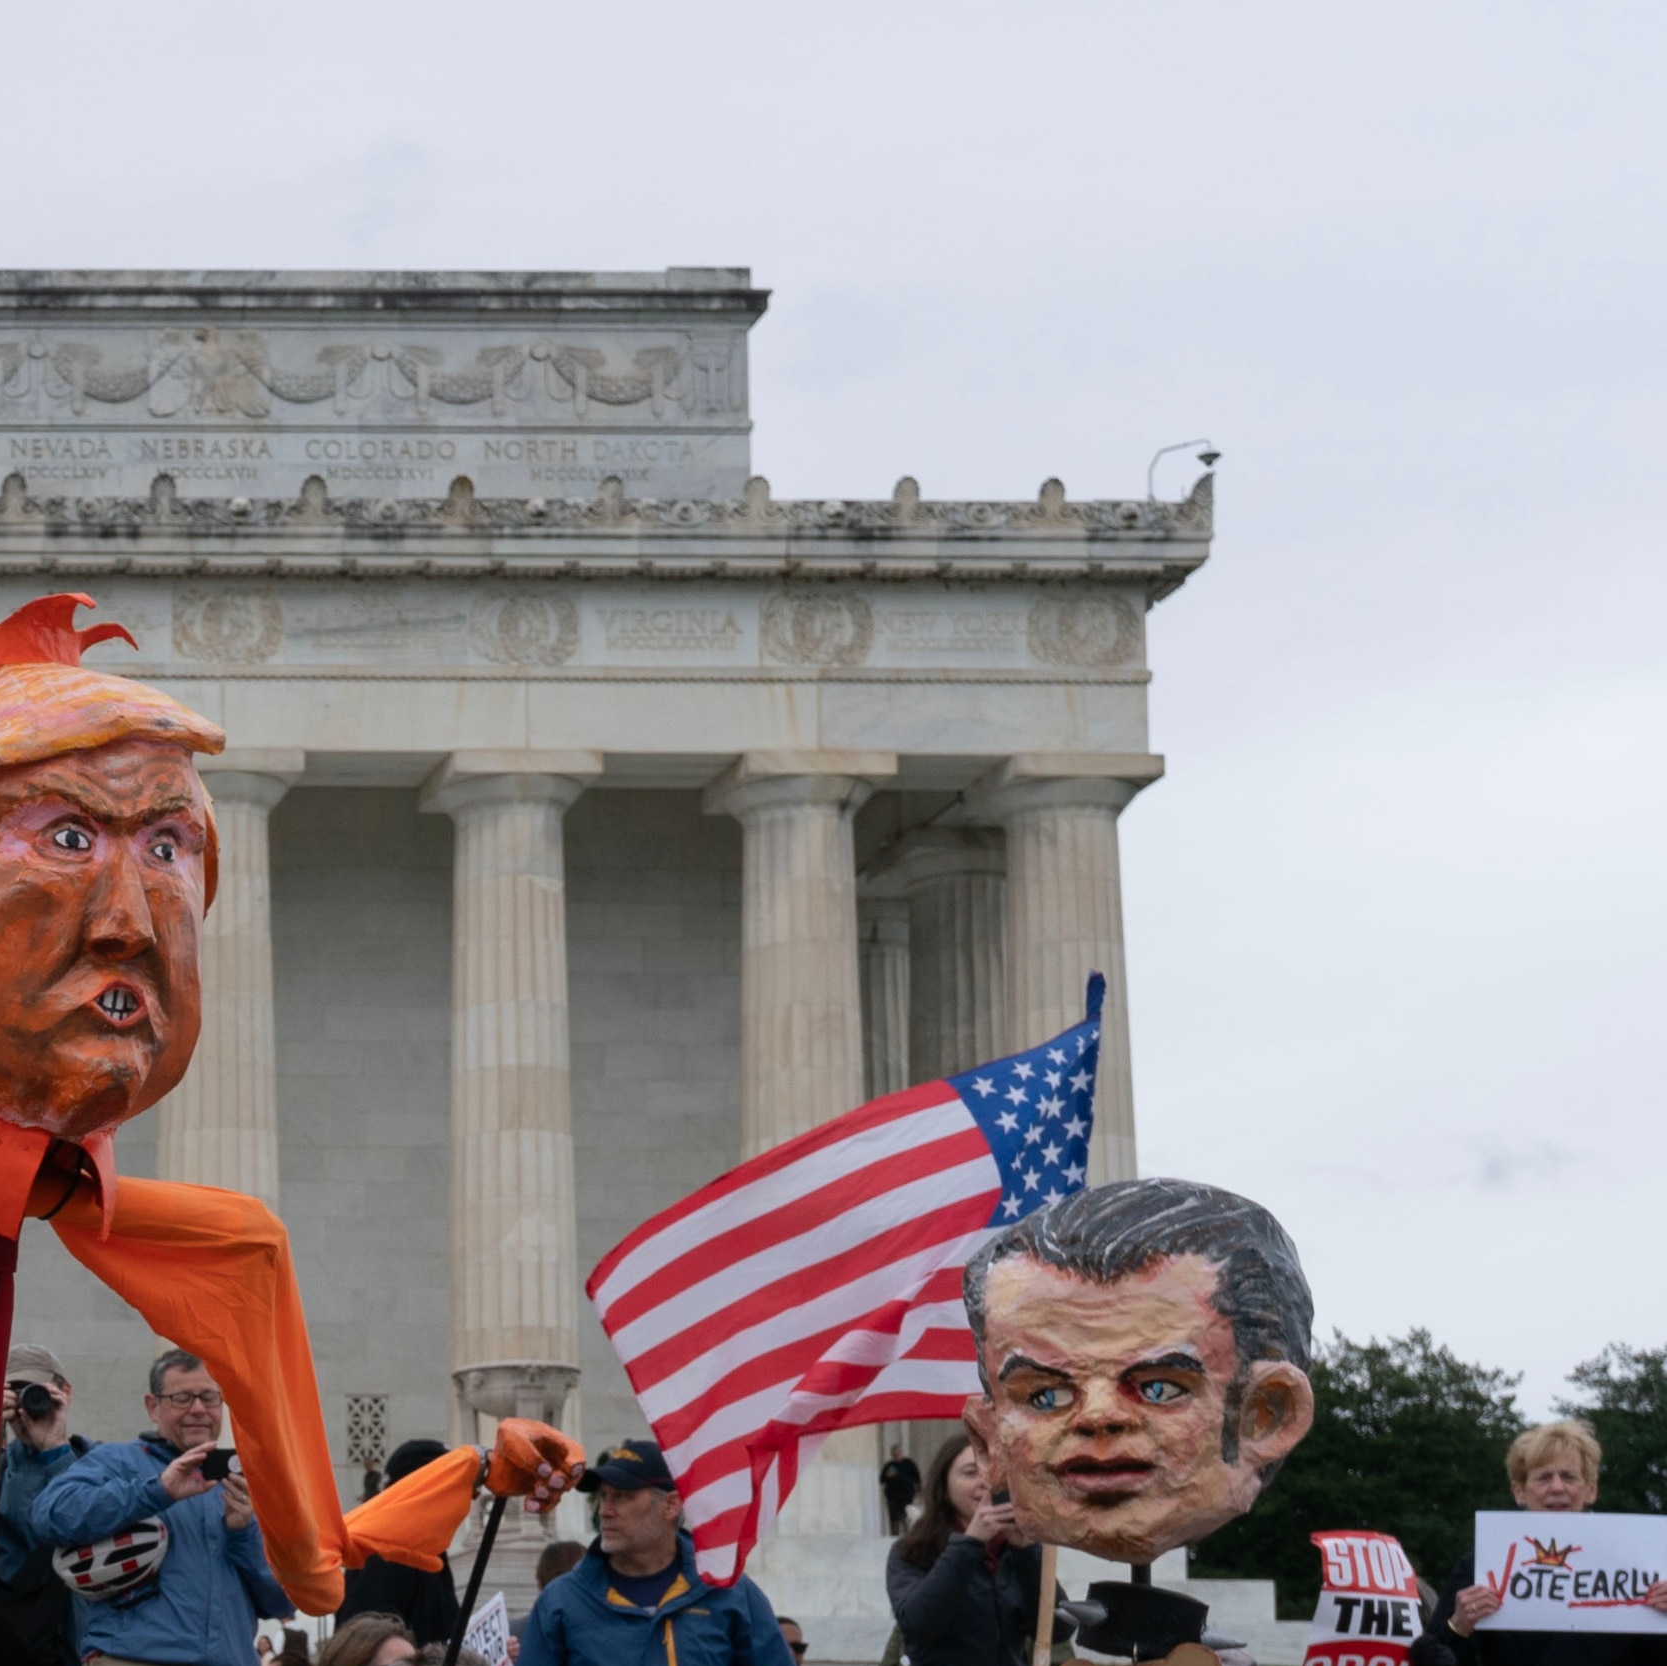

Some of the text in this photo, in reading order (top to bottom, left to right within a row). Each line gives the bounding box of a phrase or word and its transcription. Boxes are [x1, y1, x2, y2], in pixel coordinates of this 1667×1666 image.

[9, 438, 114, 460] NEVADA
[140, 438, 274, 460] NEBRASKA
[304, 438, 457, 461] COLORADO
[483, 439, 579, 461] NORTH
[593, 439, 694, 462] DAKOTA
[594, 607, 743, 634] VIRGINIA
[1322, 1536, 1415, 1592] STOP
[465, 1608, 504, 1654] OTECT
[1334, 1596, 1414, 1638] THE
